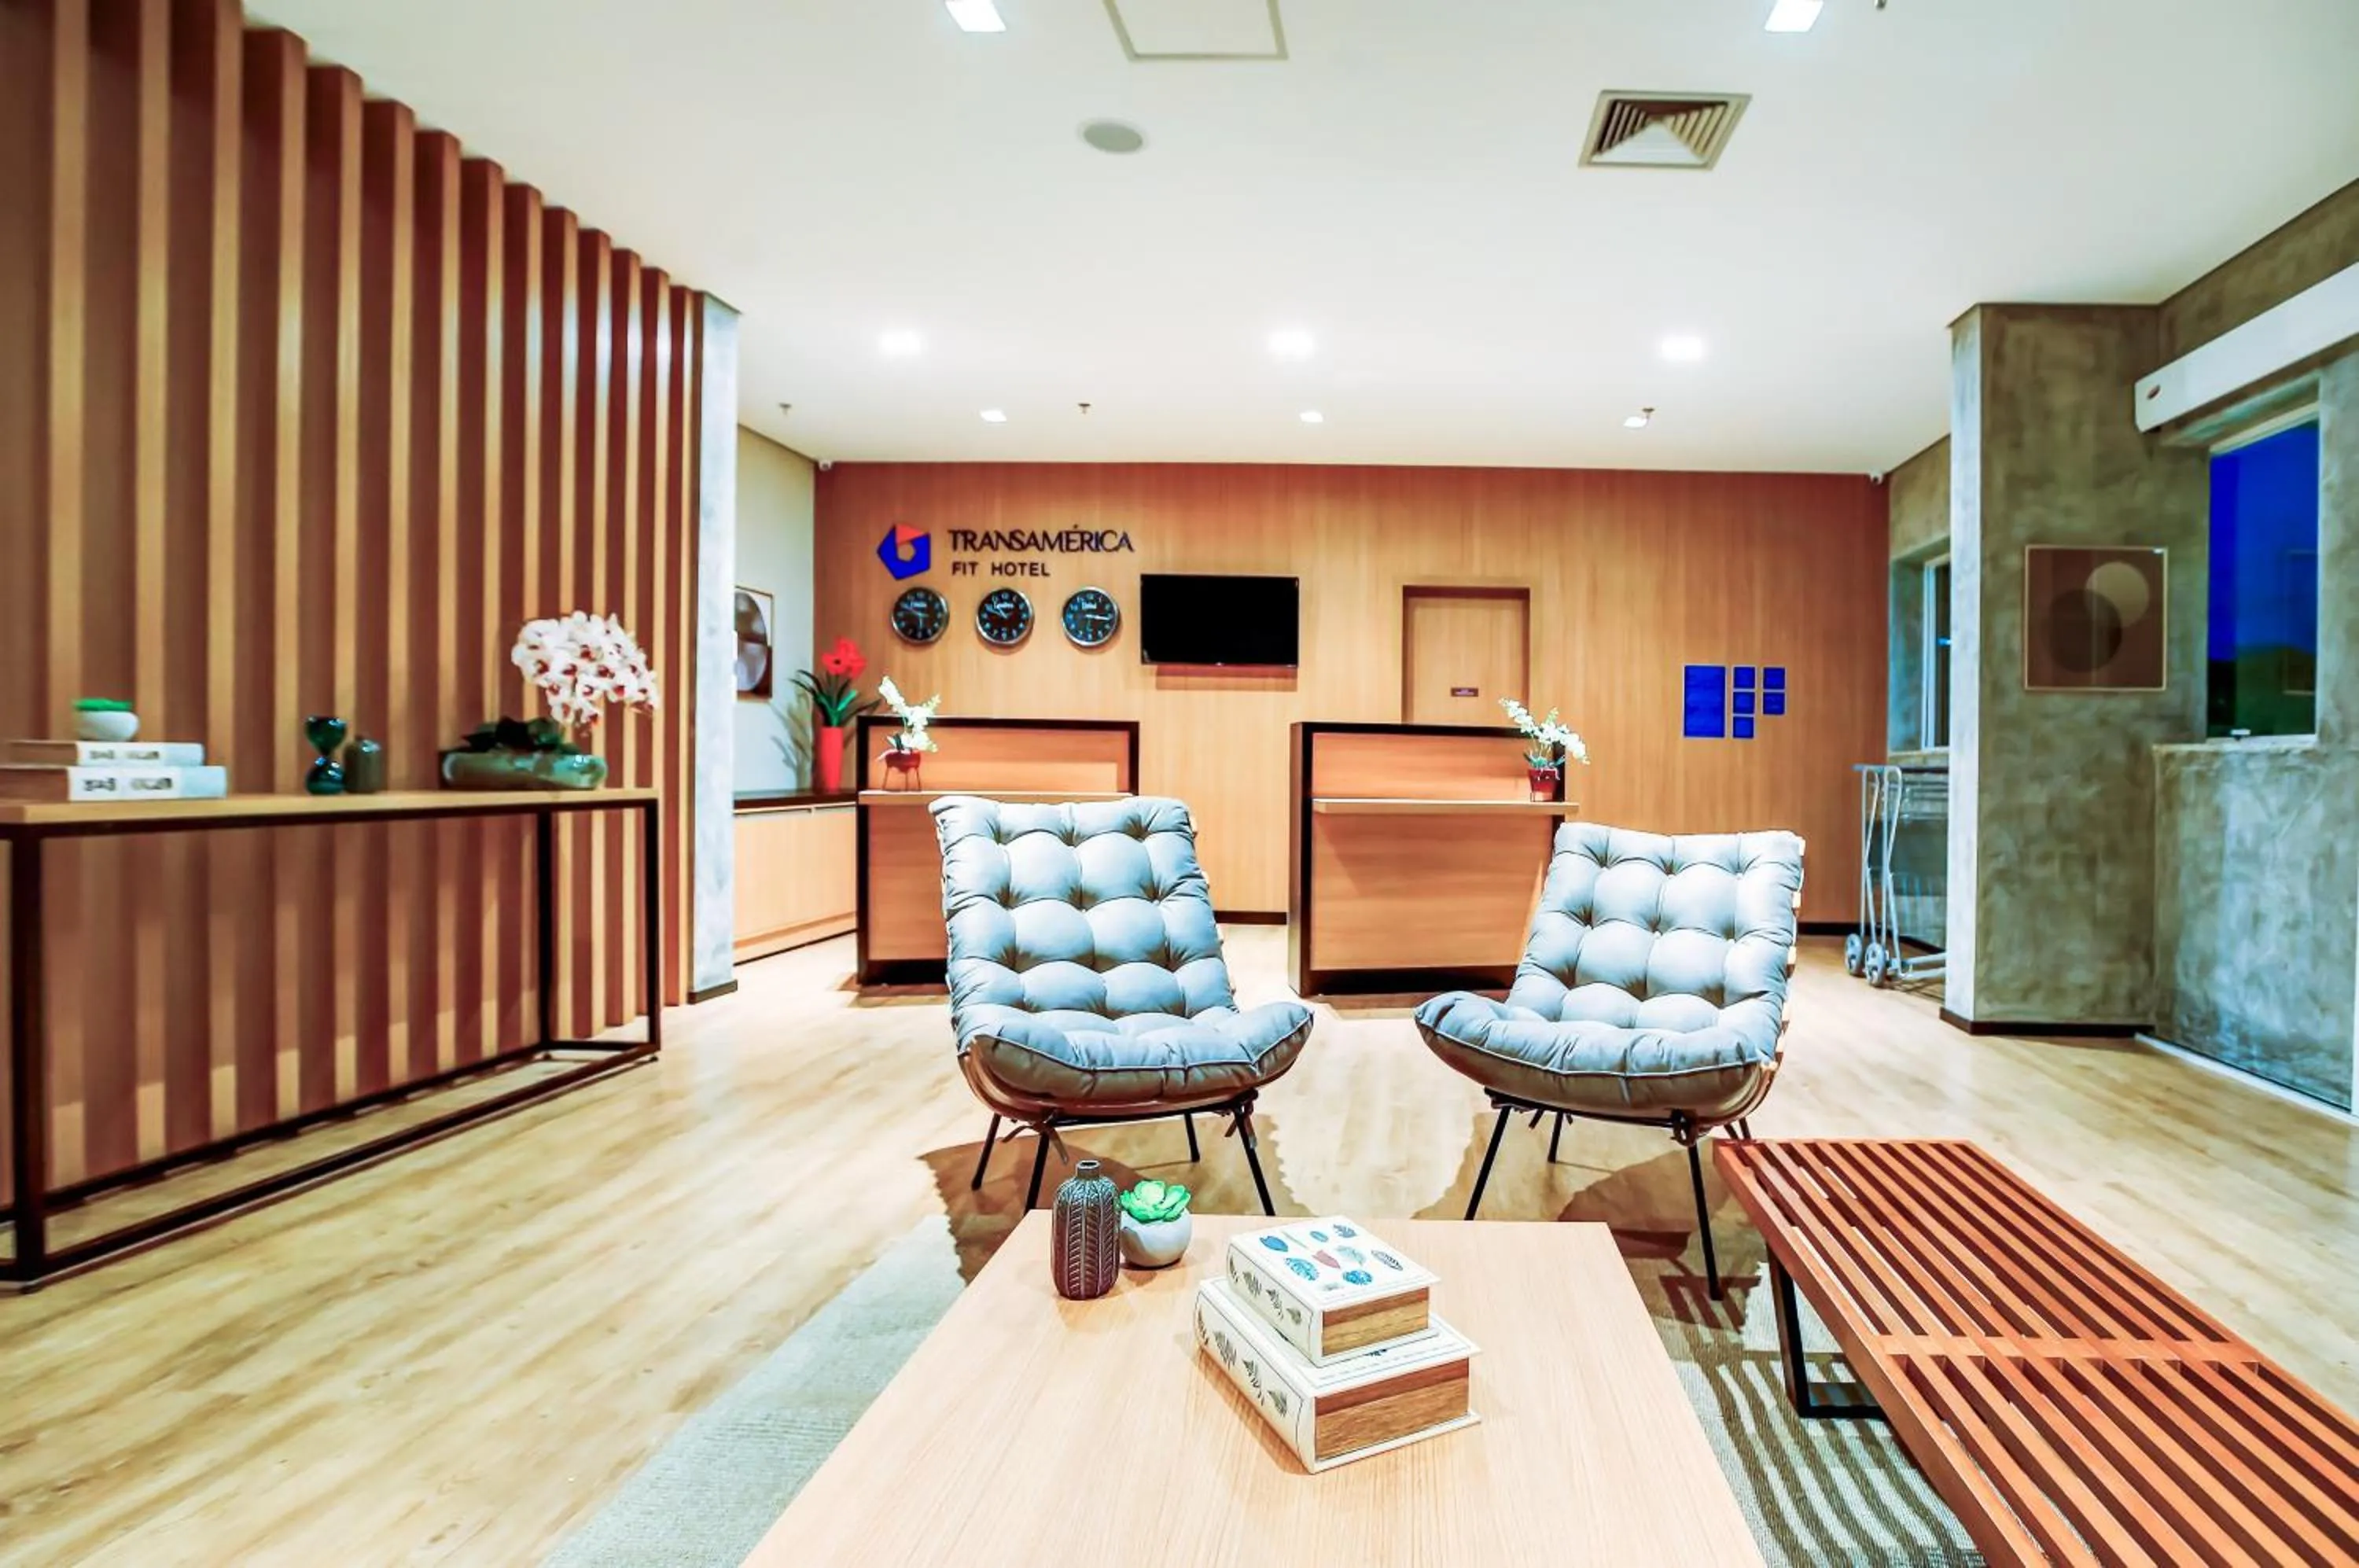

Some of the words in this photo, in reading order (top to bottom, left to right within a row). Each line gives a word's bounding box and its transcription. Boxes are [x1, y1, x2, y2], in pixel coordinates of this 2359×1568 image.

[948, 525, 1135, 553] TRANSAMÉRICA
[951, 561, 979, 576] FIT
[991, 561, 1051, 576] HOTEL
